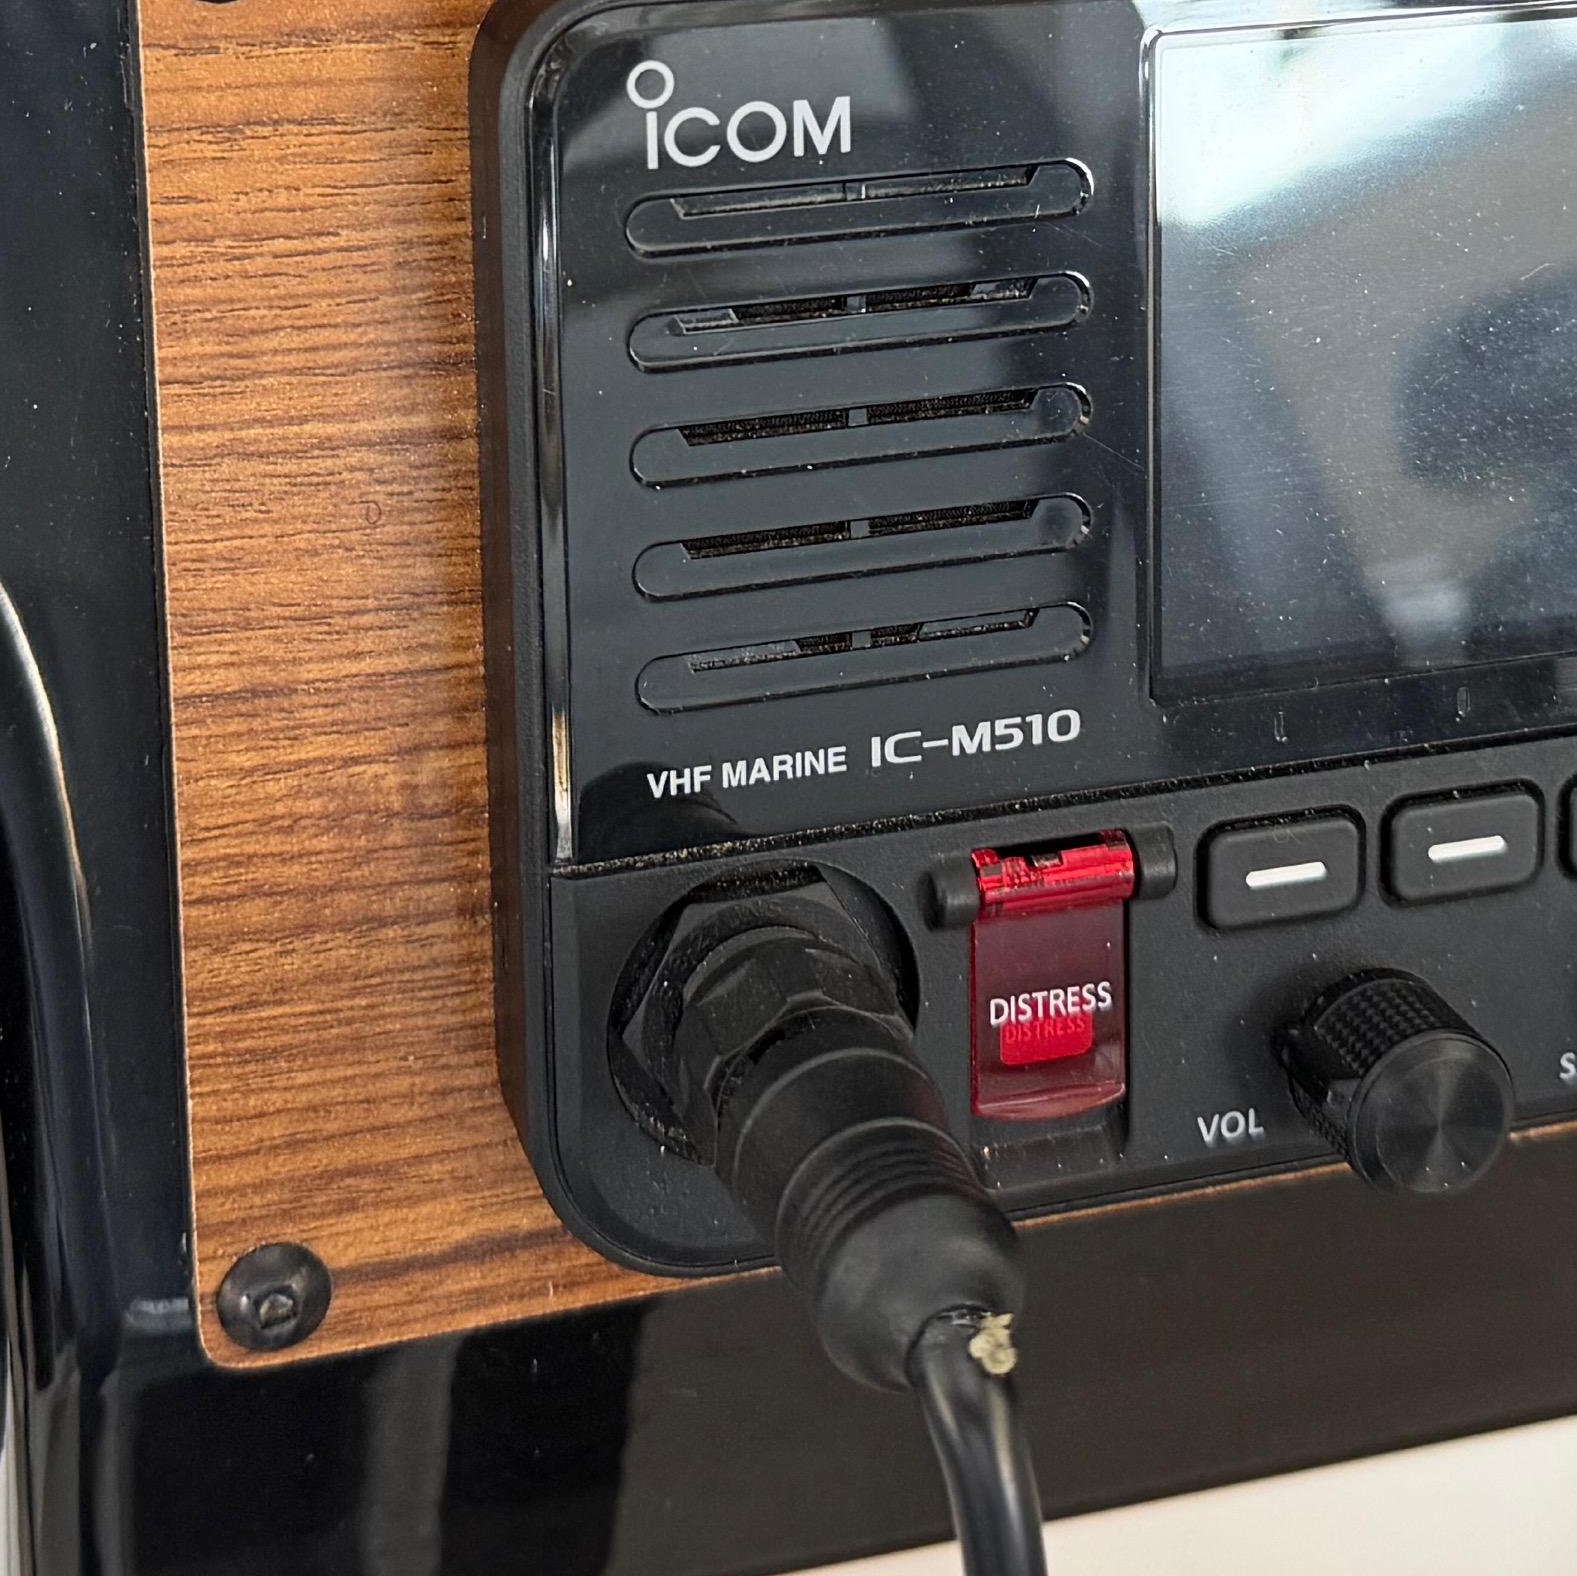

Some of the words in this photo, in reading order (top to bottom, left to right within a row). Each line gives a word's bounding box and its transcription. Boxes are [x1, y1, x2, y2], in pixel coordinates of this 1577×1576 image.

[646, 768, 713, 800] VHF
[721, 747, 848, 791] MARINE
[870, 709, 1082, 768] IC-M510
[990, 982, 1114, 1026] DISTRESS
[1197, 1108, 1264, 1146] VOL
